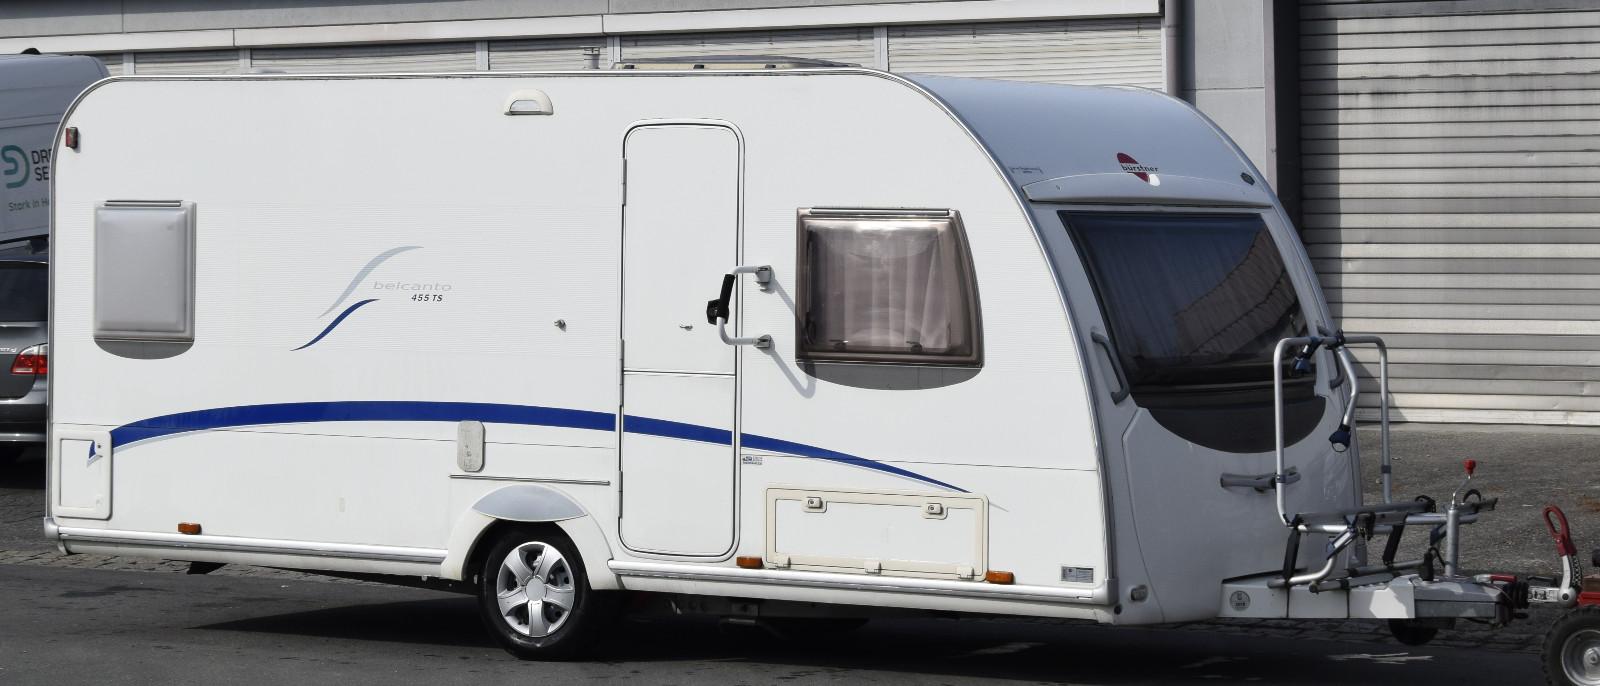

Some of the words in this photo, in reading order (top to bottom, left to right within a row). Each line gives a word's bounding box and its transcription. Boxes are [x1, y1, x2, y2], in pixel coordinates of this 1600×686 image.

[1120, 164, 1159, 172] bürstner
[373, 280, 452, 292] belcanto
[411, 293, 430, 302] 455
[432, 294, 443, 302] TS
